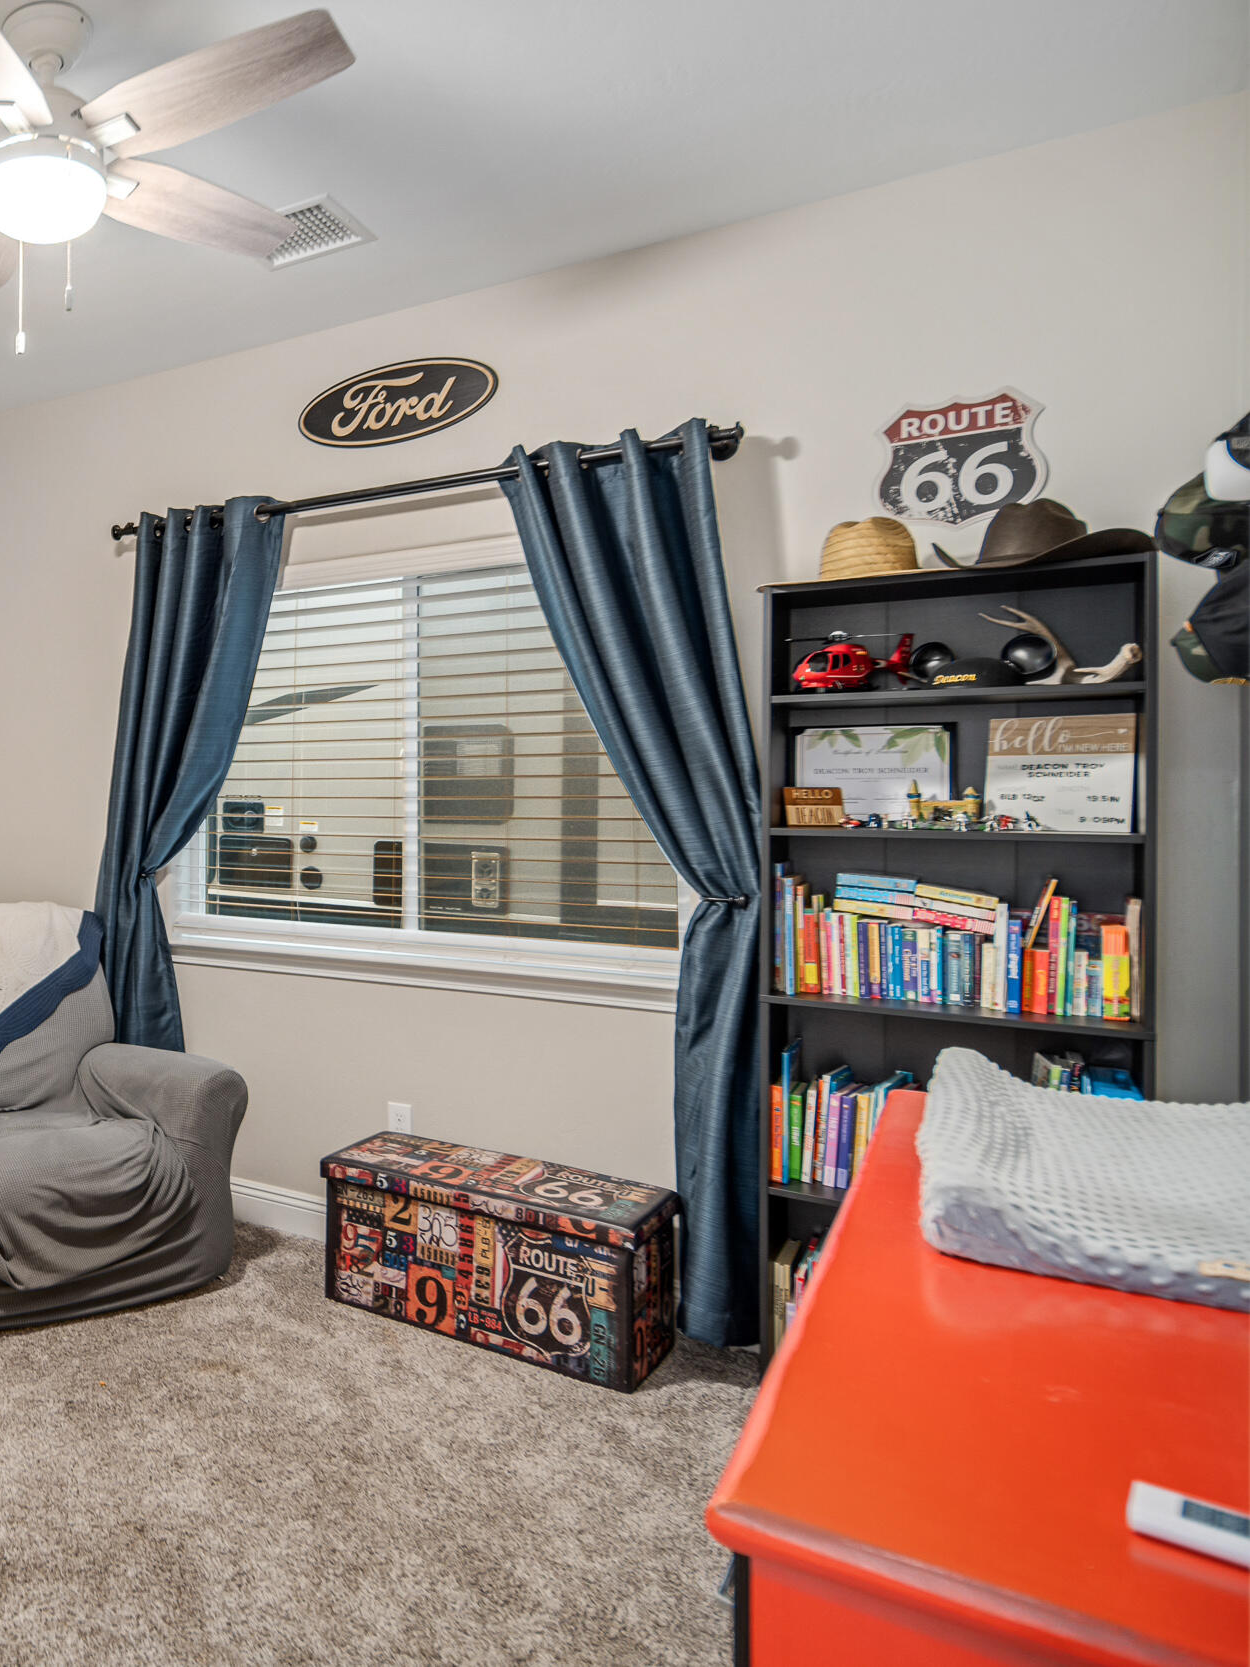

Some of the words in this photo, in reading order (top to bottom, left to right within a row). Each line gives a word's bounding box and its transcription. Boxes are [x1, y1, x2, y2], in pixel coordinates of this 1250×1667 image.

[331, 371, 457, 437] Ford
[900, 401, 1014, 440] ROUTE
[901, 441, 1014, 510] 66
[932, 673, 977, 685] Deacon
[988, 716, 1071, 756] hello
[1021, 763, 1069, 771] DEACON
[791, 789, 834, 799] HELLO
[375, 1173, 389, 1189] 5
[534, 1181, 603, 1207] 66
[388, 1194, 412, 1226] 2
[385, 1231, 398, 1249] 5
[402, 1235, 415, 1254] 3
[519, 1245, 578, 1277] ROUTE
[415, 1275, 448, 1326] 9
[515, 1277, 582, 1346] 66
